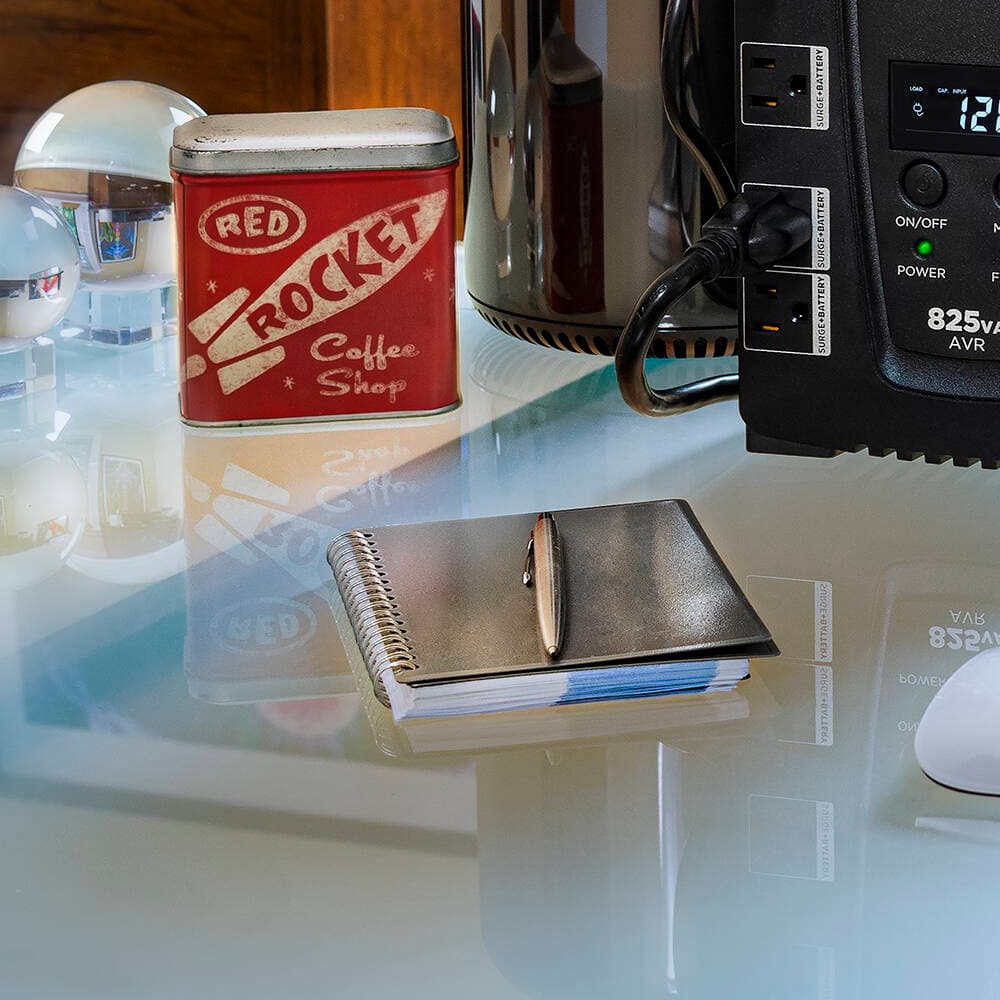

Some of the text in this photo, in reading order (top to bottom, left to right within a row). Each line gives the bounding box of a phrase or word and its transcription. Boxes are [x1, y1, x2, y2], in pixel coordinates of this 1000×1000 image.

[816, 48, 824, 128] SURGE+BATTERY
[215, 206, 289, 238] RED
[816, 190, 825, 268] SURGE+BATTERY
[895, 216, 948, 230] ON/OFF
[246, 202, 420, 340] ROCKET
[897, 265, 946, 279] POWER
[818, 276, 826, 354] SURGE+BATTERY
[310, 332, 420, 372] Coffee
[948, 336, 986, 352] AVR
[316, 366, 408, 404] Shop
